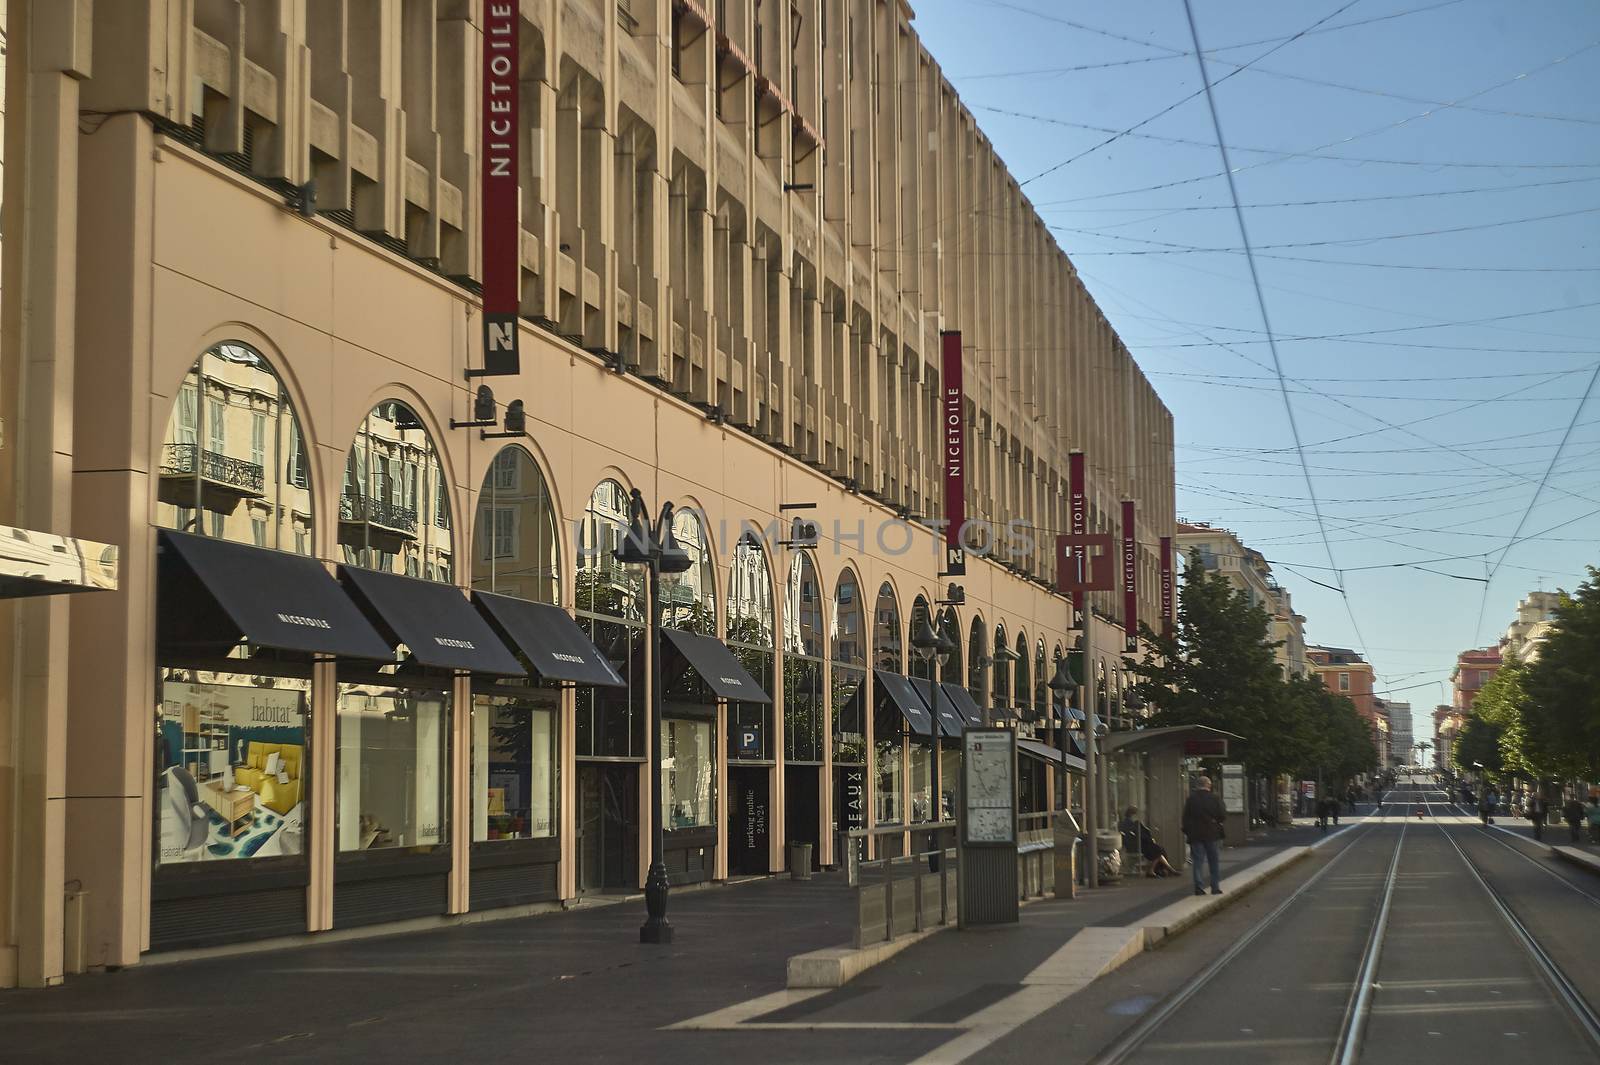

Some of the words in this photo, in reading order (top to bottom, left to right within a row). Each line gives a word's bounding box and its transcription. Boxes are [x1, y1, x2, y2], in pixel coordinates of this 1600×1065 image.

[491, 3, 511, 177] NICETOILE
[949, 388, 959, 476] NICETOILE
[1073, 493, 1083, 559] NIETOILE
[1126, 537, 1134, 592] NICETOILE
[1162, 568, 1171, 618] NICETOILE
[277, 613, 331, 629] NICETOILE
[434, 637, 476, 650] NICETOILE
[552, 652, 585, 664] NICETOILE
[252, 698, 291, 724] habitat
[743, 733, 755, 747] P
[747, 790, 756, 814] public
[747, 816, 756, 848] parking
